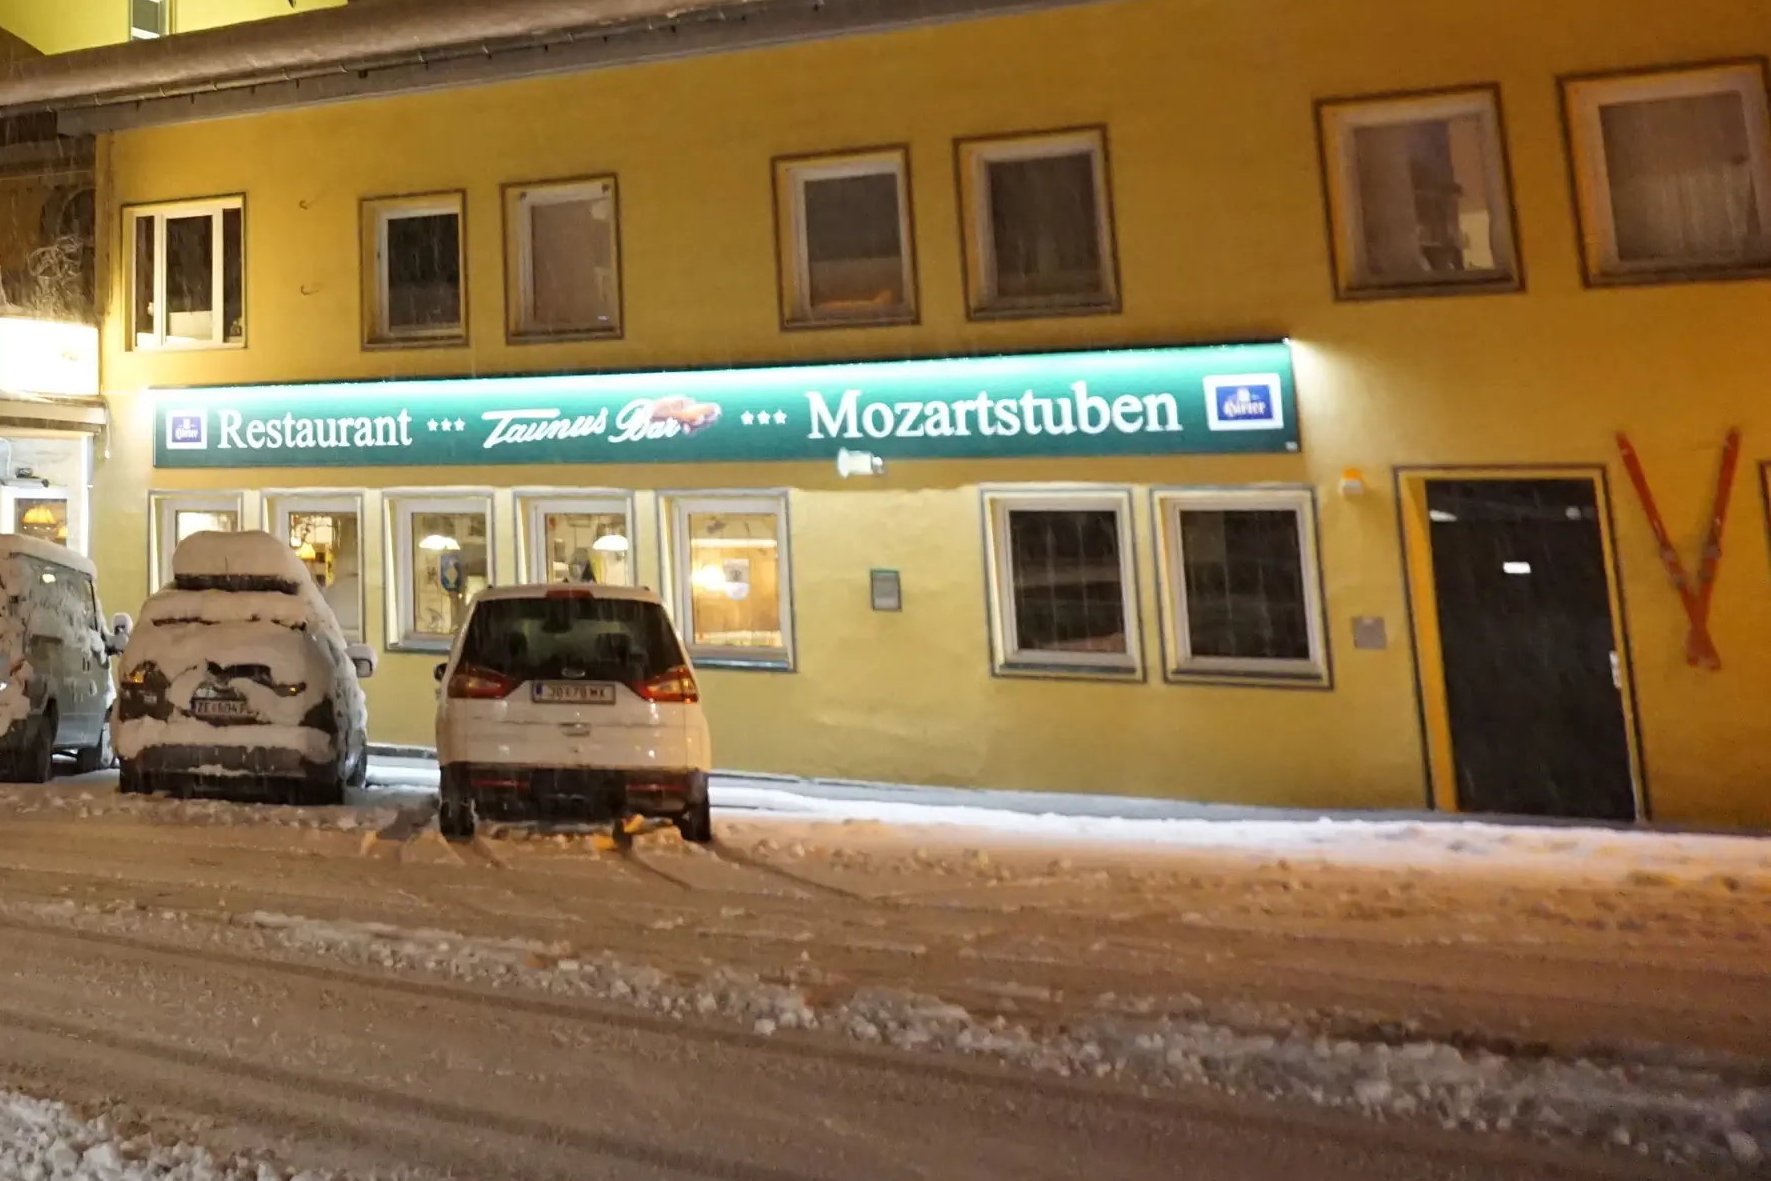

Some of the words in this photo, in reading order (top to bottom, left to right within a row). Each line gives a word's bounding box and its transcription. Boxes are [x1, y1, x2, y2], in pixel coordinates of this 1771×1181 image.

[216, 407, 414, 449] Restaurant
[481, 406, 609, 449] Taunus
[608, 397, 681, 443] Bar
[804, 380, 1183, 440] Mozartstuben
